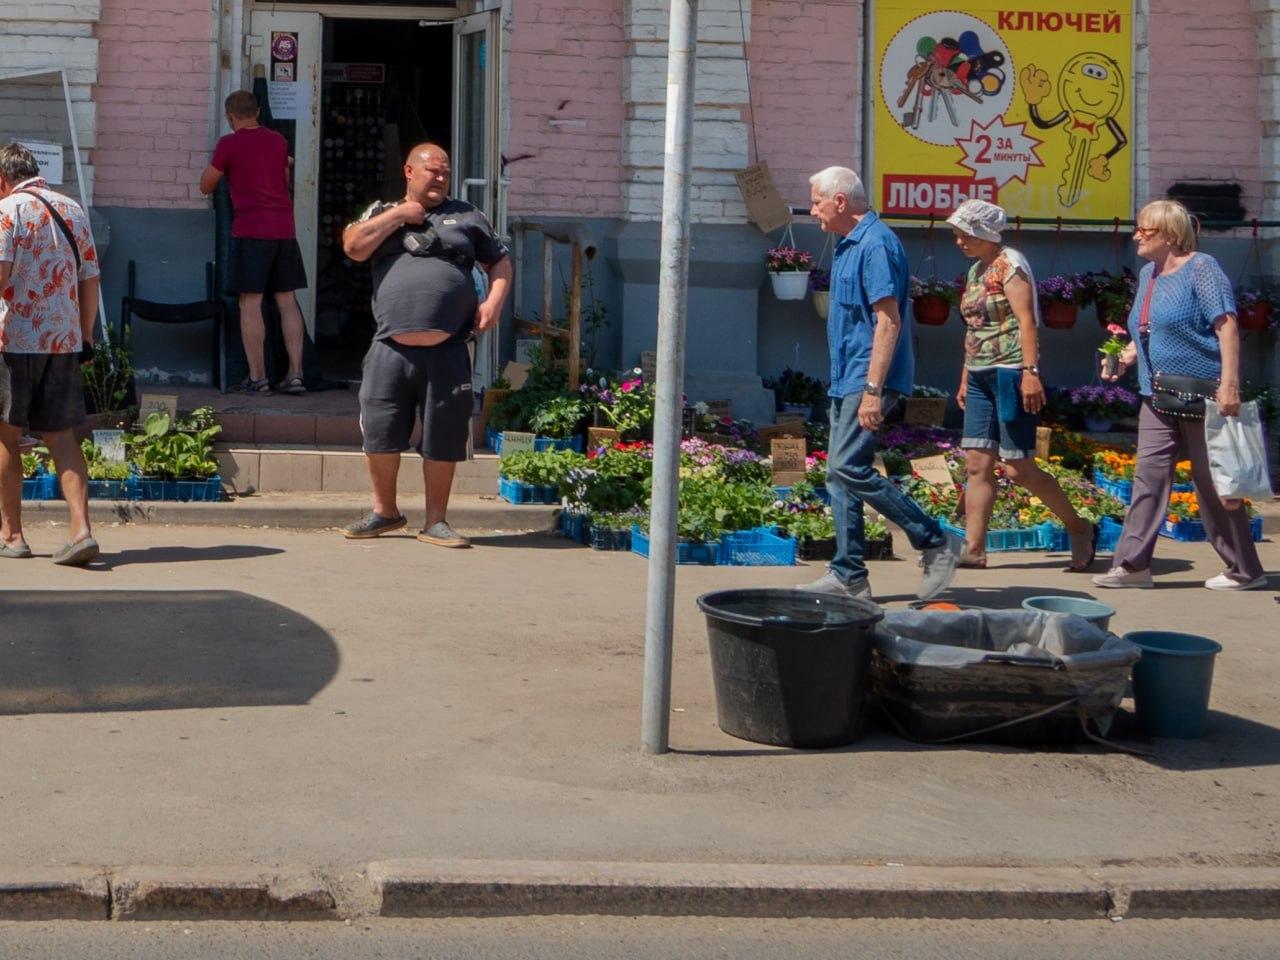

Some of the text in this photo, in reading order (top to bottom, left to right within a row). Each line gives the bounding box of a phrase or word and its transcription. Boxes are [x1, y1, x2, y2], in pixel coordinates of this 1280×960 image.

[997, 9, 1121, 33] КЛЮЧЕЙ
[974, 134, 1013, 164] 2 ЗА
[994, 153, 1031, 162] МИНУТЫ
[888, 182, 993, 209] ЛЮБЫЕ
